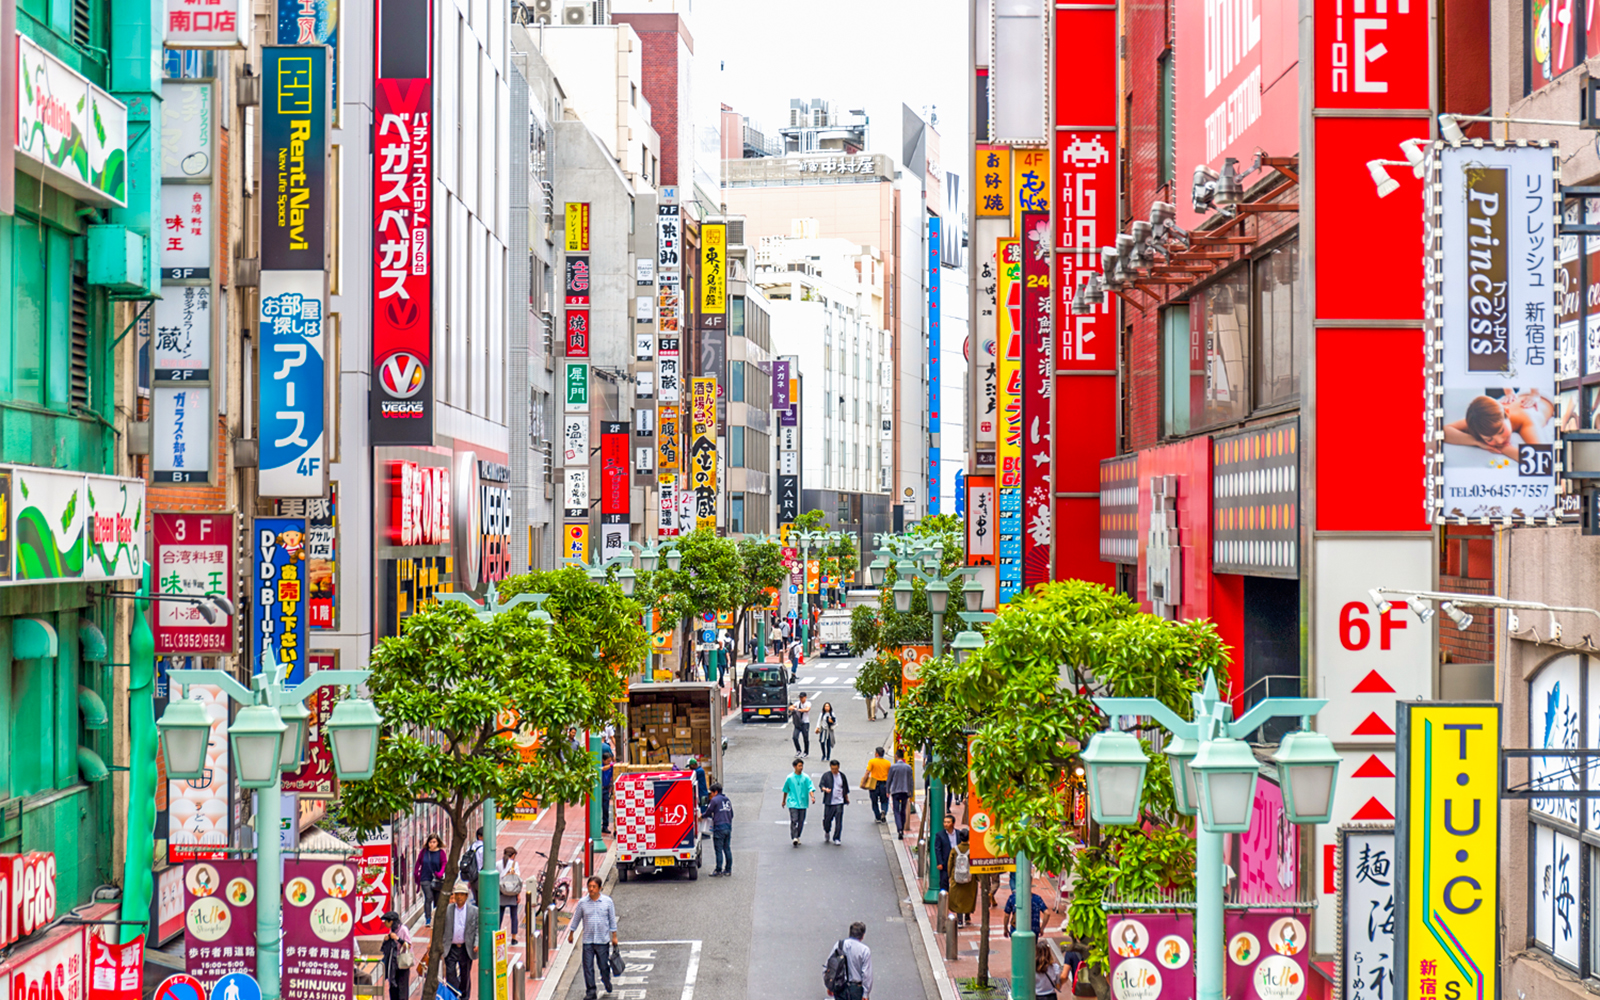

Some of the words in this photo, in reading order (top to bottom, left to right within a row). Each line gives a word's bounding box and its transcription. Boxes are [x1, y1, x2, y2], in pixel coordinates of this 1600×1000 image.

[169, 11, 236, 32] 南口店
[1205, 101, 1227, 164] TAITO
[1228, 64, 1262, 146] STATION
[278, 148, 287, 171] New
[413, 112, 428, 226] パチンコ・スロット
[821, 156, 875, 174] 中村屋
[1024, 153, 1044, 166] 4F
[278, 172, 287, 193] Life
[663, 188, 674, 198] M
[983, 152, 1004, 211] お好焼
[190, 192, 202, 236] 台湾料理
[277, 194, 287, 227] Space
[378, 112, 411, 299] ベガスベガス
[660, 206, 677, 214] 7F
[1063, 173, 1073, 247] TAITO
[165, 215, 185, 251] 味王
[1525, 174, 1545, 287] リフレッシュ
[172, 269, 193, 278] 3F
[1468, 188, 1500, 355] Princess
[197, 287, 209, 311] 会津
[263, 295, 320, 321] お部屋
[1063, 256, 1073, 360] STATION
[183, 287, 195, 359] 喜多方ラーメン
[273, 317, 320, 335] 探しは
[704, 317, 722, 326] 4F
[1492, 280, 1508, 353] プリンセス
[156, 326, 182, 352] 蔵
[569, 314, 586, 348] 焼肉
[1525, 302, 1546, 365] 新宿店
[661, 340, 677, 349] 5F
[171, 370, 193, 380] 2F
[777, 364, 785, 388] メガネ
[273, 343, 308, 448] アース
[382, 404, 423, 412] VEGAS
[694, 382, 705, 410] 酒場
[705, 381, 714, 428] きんくら
[173, 391, 187, 468] ガラスの部屋
[610, 424, 620, 433] 2F
[296, 458, 320, 476] 4F
[1520, 445, 1553, 475] 3F
[172, 472, 190, 482] B1
[682, 493, 694, 504] 2F
[784, 478, 794, 519] ZARA
[94, 511, 114, 543] Green
[116, 512, 132, 543] Peas
[610, 515, 620, 523] 1F
[163, 550, 225, 564] 台湾料理
[169, 606, 219, 620] 小酒
[1338, 600, 1409, 651] 6F
[160, 633, 226, 648] TEL(3352)9534
[12, 853, 56, 941] Peas
[189, 946, 256, 959] 歩行者用道路
[286, 946, 351, 960] 歩行者用道路
[121, 943, 140, 991] 新台
[1420, 959, 1437, 1000] 新宿
[288, 990, 346, 1000] MUSASHINO
[289, 979, 346, 992] SHINJUKU
